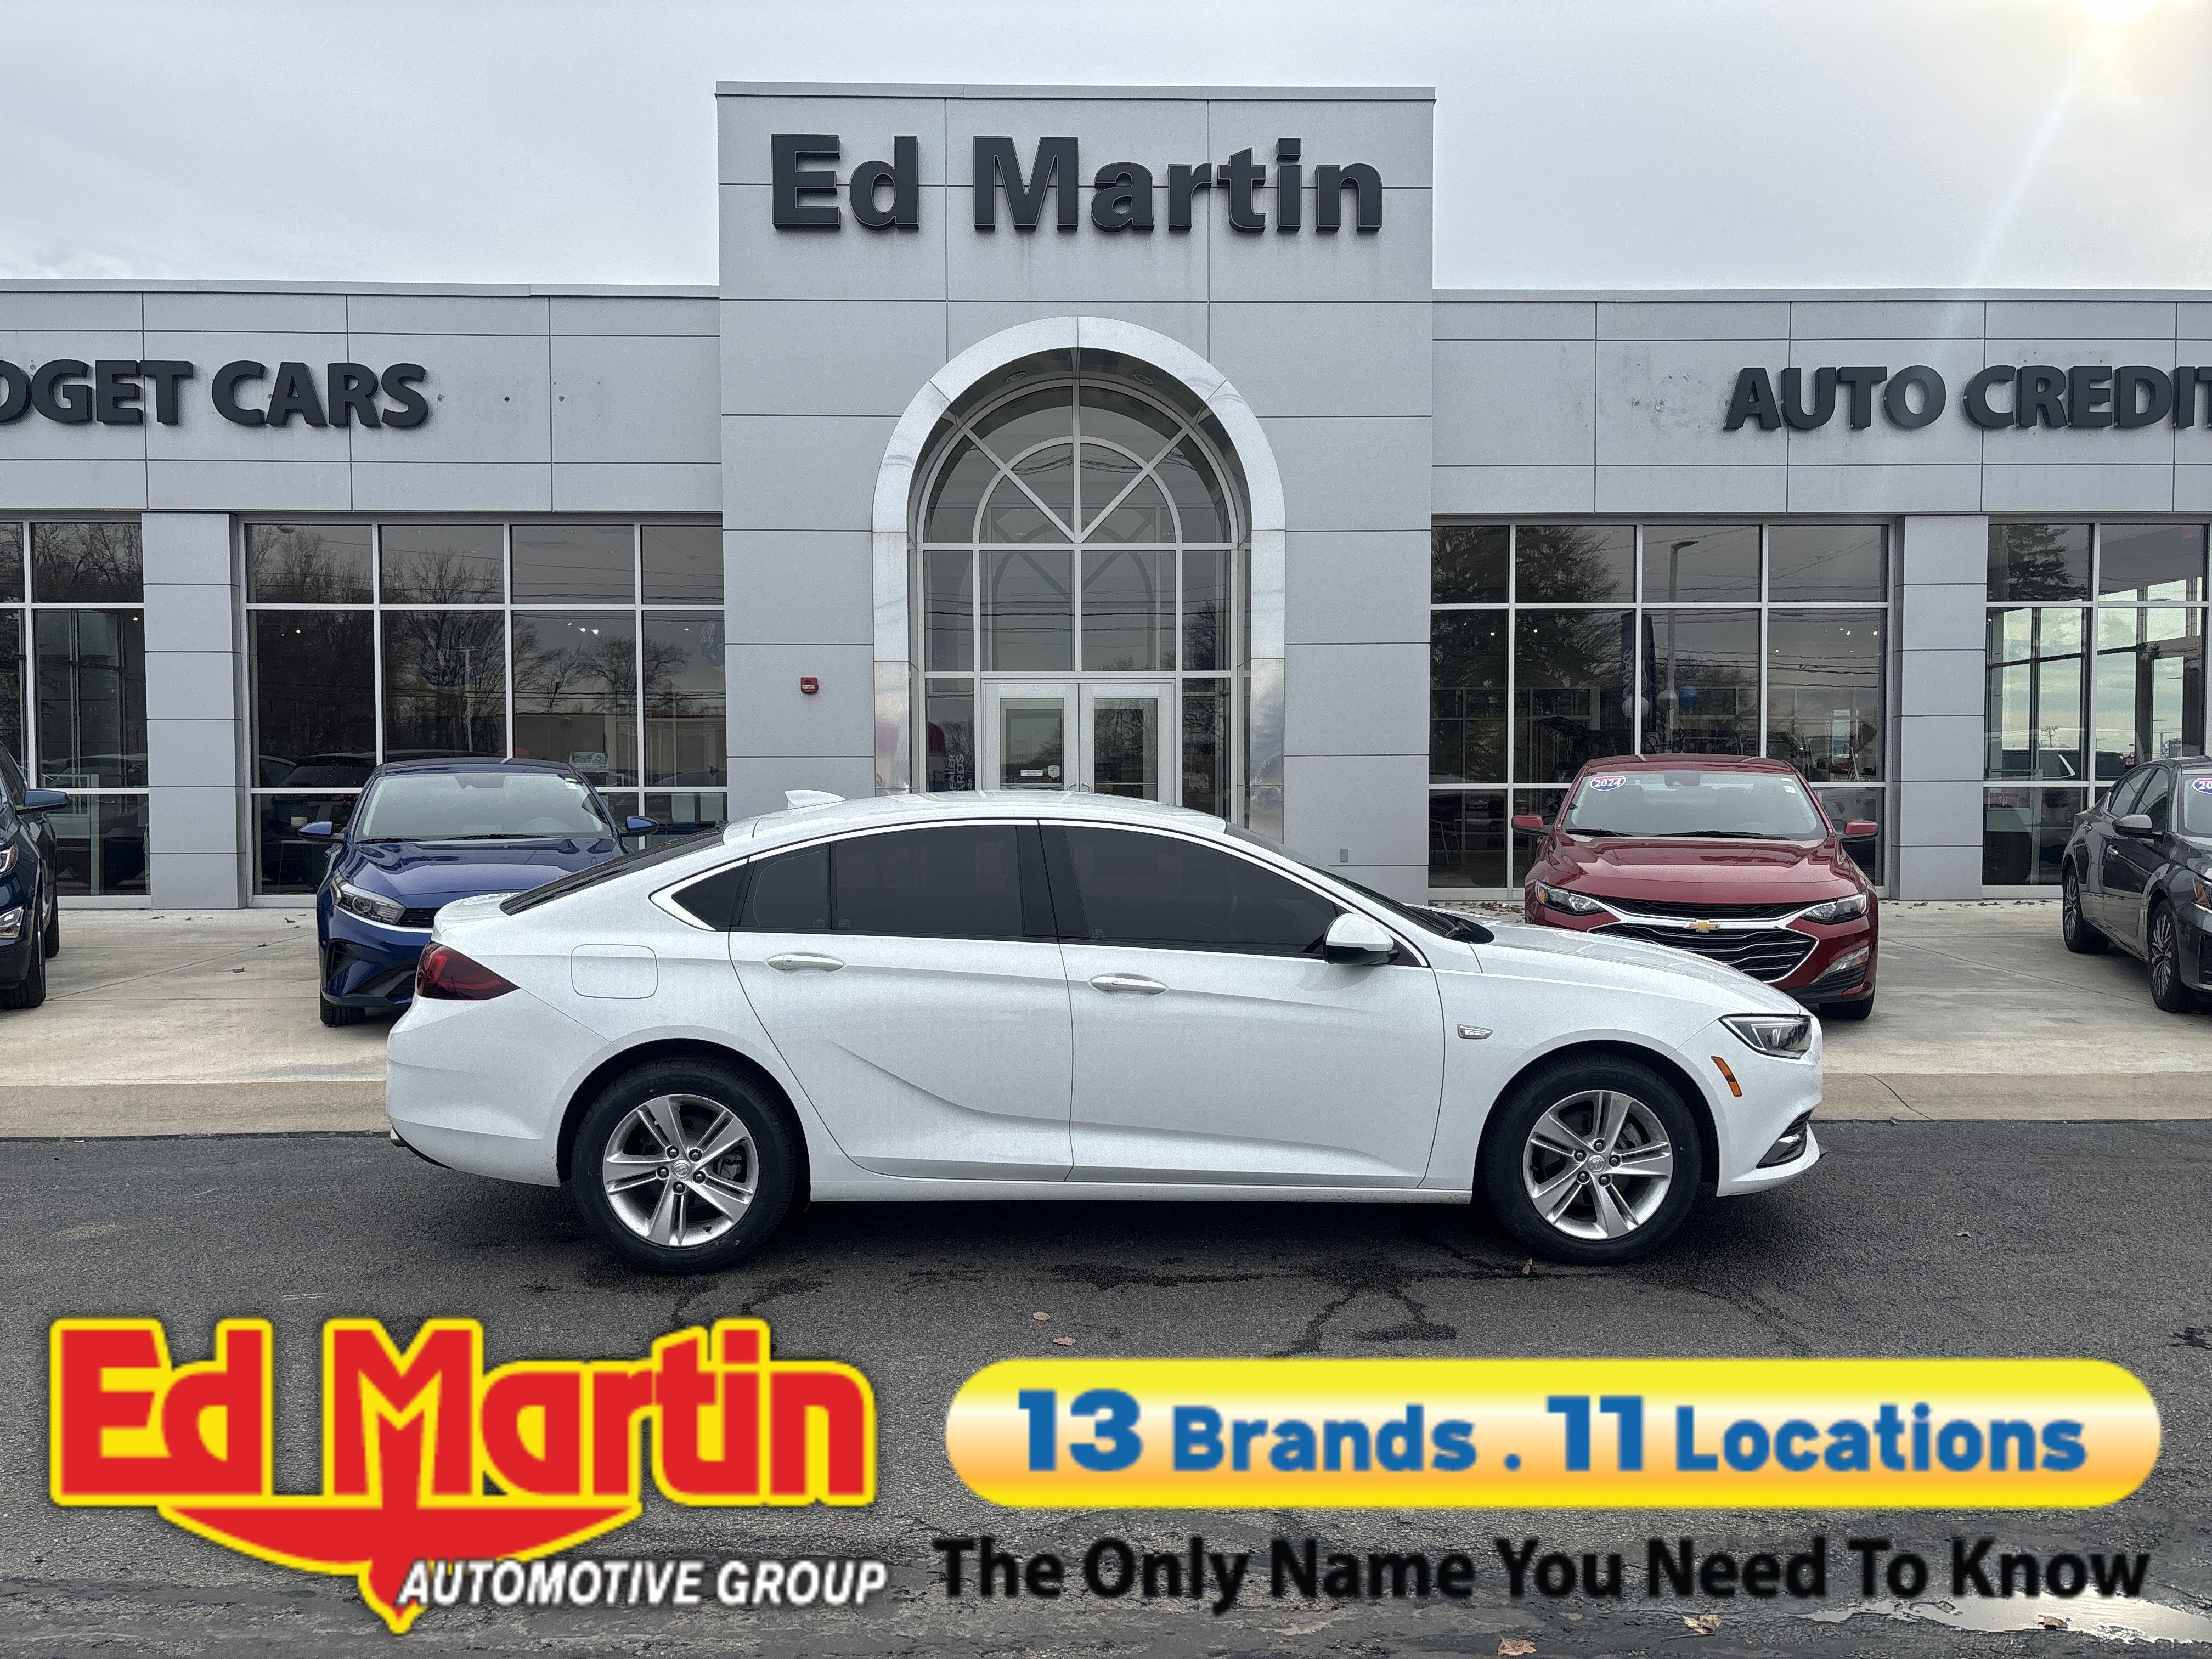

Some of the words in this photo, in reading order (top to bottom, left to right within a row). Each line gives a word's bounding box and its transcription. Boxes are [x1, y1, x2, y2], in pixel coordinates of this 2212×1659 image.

[771, 134, 919, 230] Ed
[973, 137, 1383, 234] Martin
[211, 360, 430, 428] CARS
[1723, 365, 1947, 431] AUTO
[1594, 778, 1621, 787] 2024
